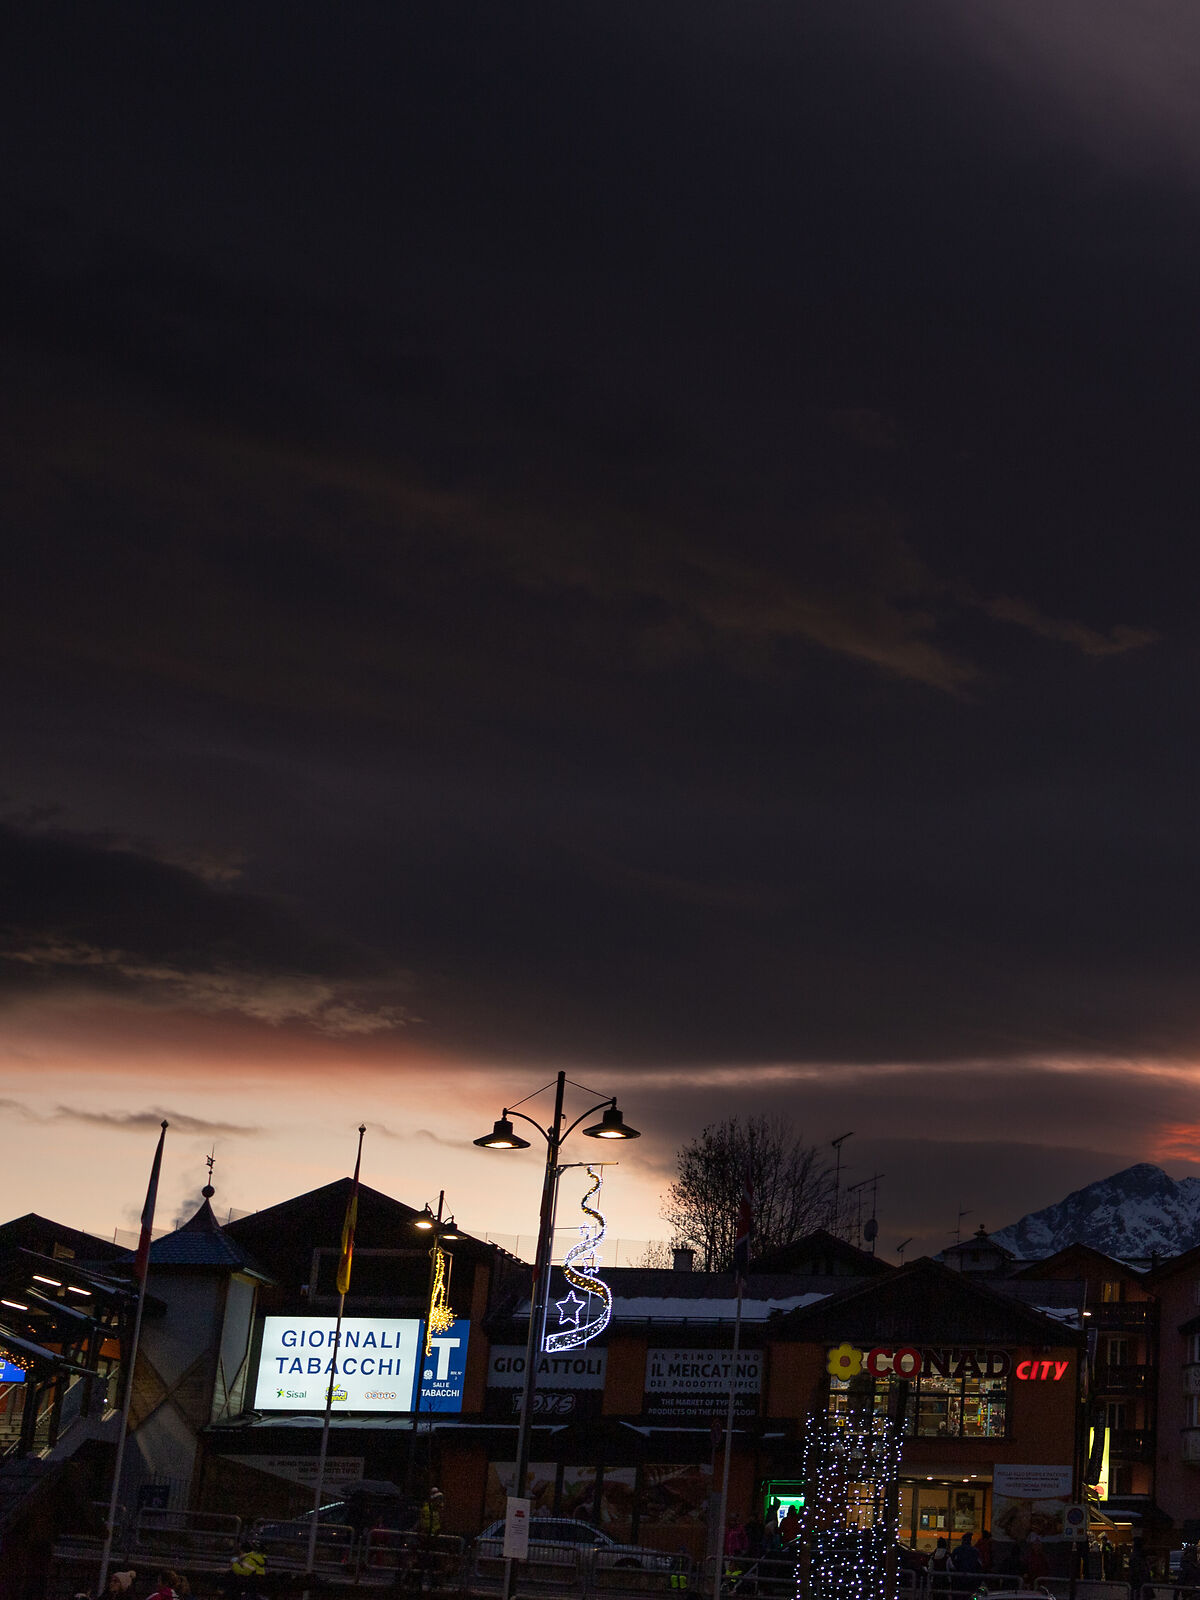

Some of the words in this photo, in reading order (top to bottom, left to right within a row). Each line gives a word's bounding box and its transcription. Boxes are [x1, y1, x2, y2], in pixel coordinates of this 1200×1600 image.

[281, 1330, 401, 1349] GIORNALI
[276, 1357, 401, 1376] TABACCHI
[431, 1337, 461, 1380] T
[494, 1358, 602, 1375] GIOATTOLI
[867, 1348, 1011, 1379] CONAD
[1015, 1360, 1069, 1381] CITY
[651, 1364, 664, 1377] IL
[667, 1363, 759, 1378] MERCATNO
[672, 1380, 722, 1388] PRODOTTI
[286, 1390, 307, 1399] Sisal
[421, 1389, 460, 1397] TABACCHI
